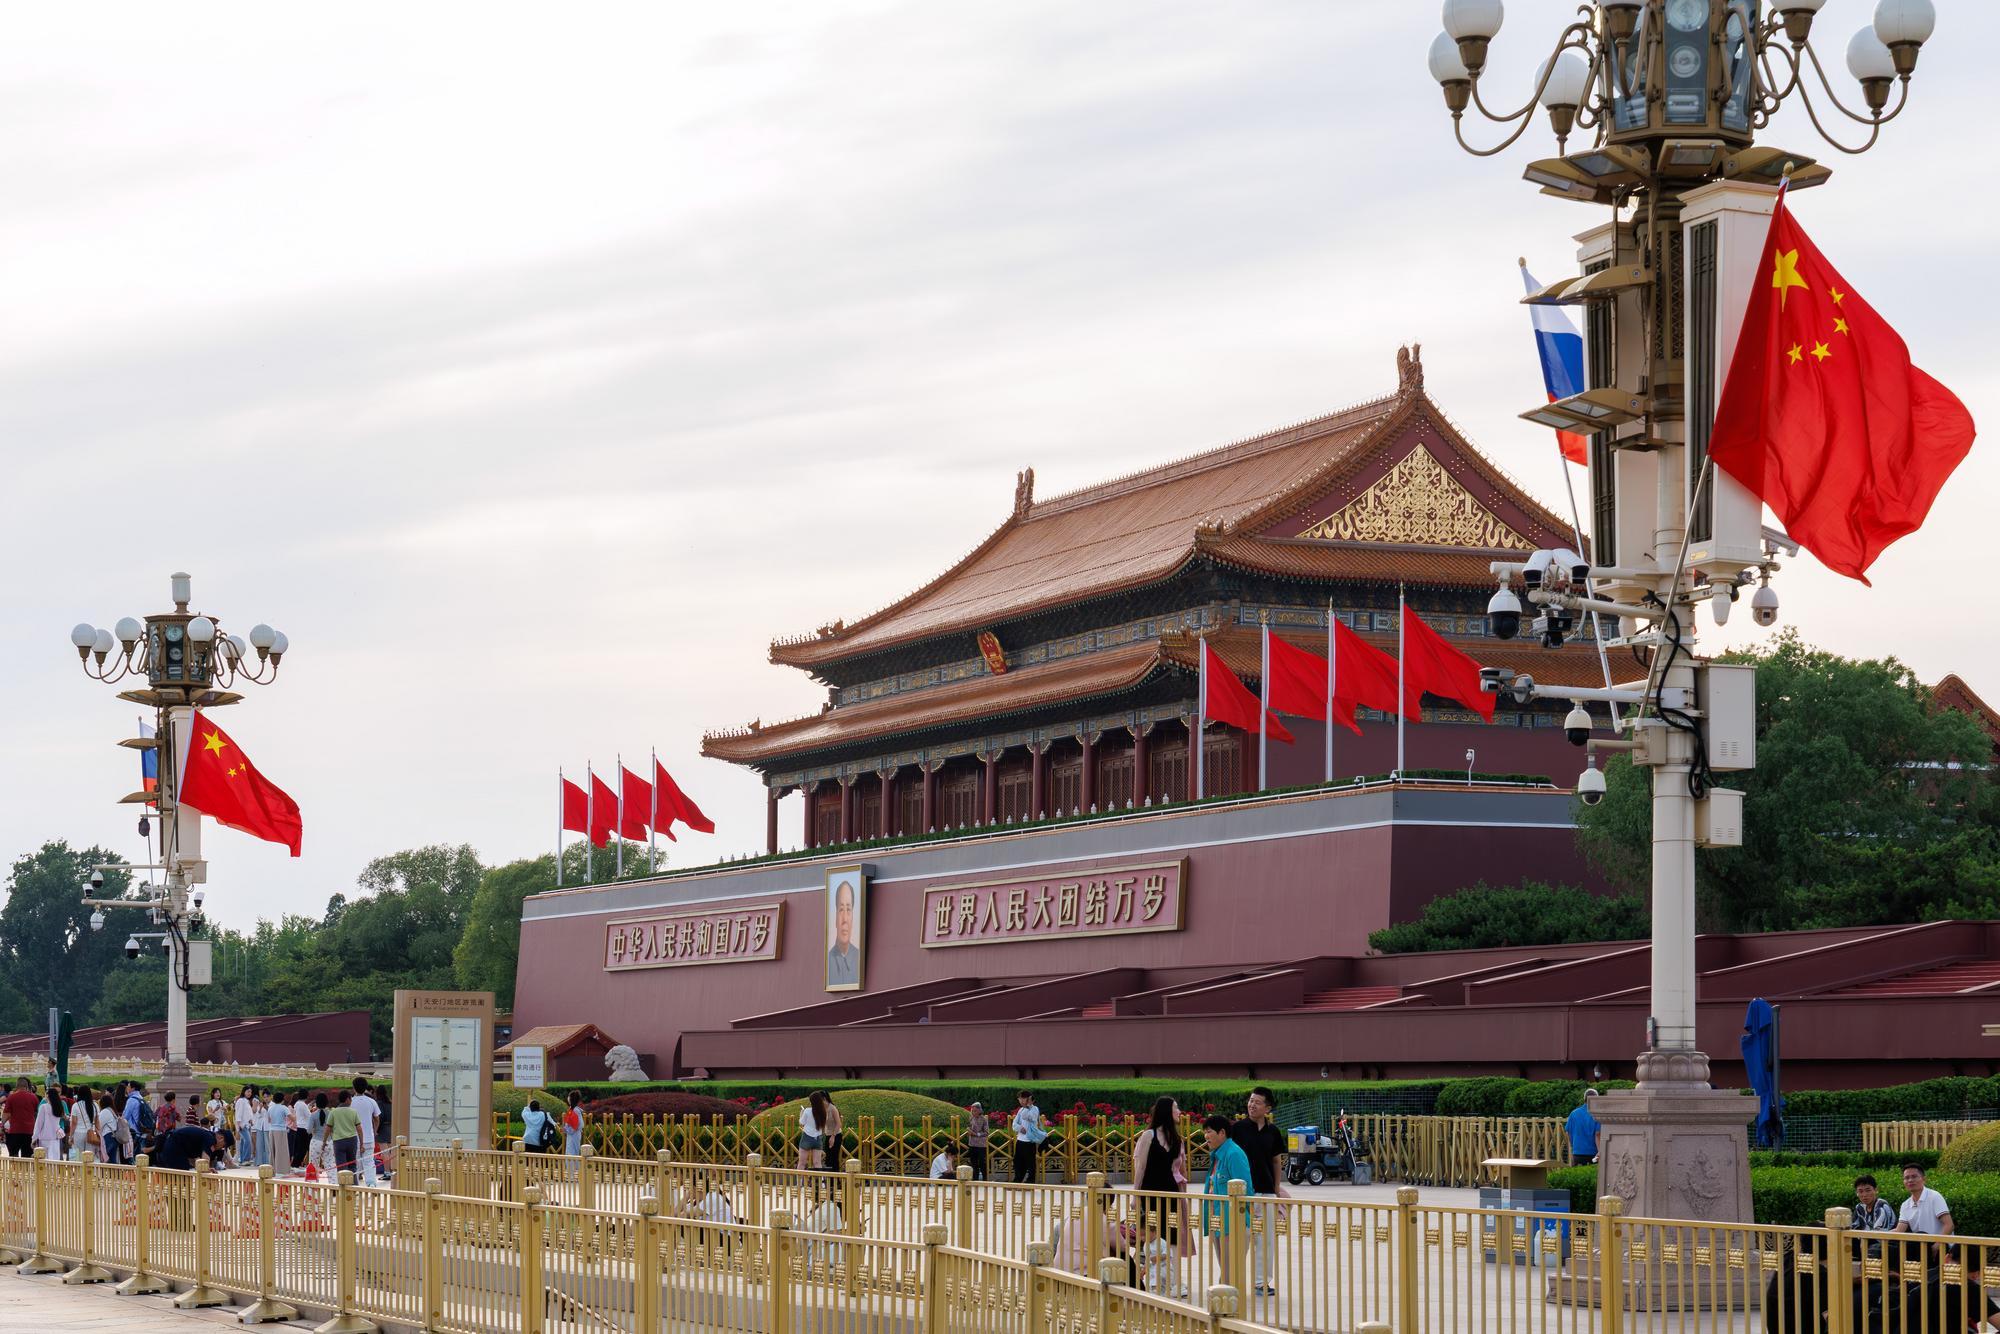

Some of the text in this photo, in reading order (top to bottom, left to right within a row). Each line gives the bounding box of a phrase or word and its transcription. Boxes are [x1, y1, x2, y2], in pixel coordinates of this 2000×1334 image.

[935, 875, 1167, 937] 世界人民大团结万岁
[612, 915, 770, 962] 中华人民共和国万岁
